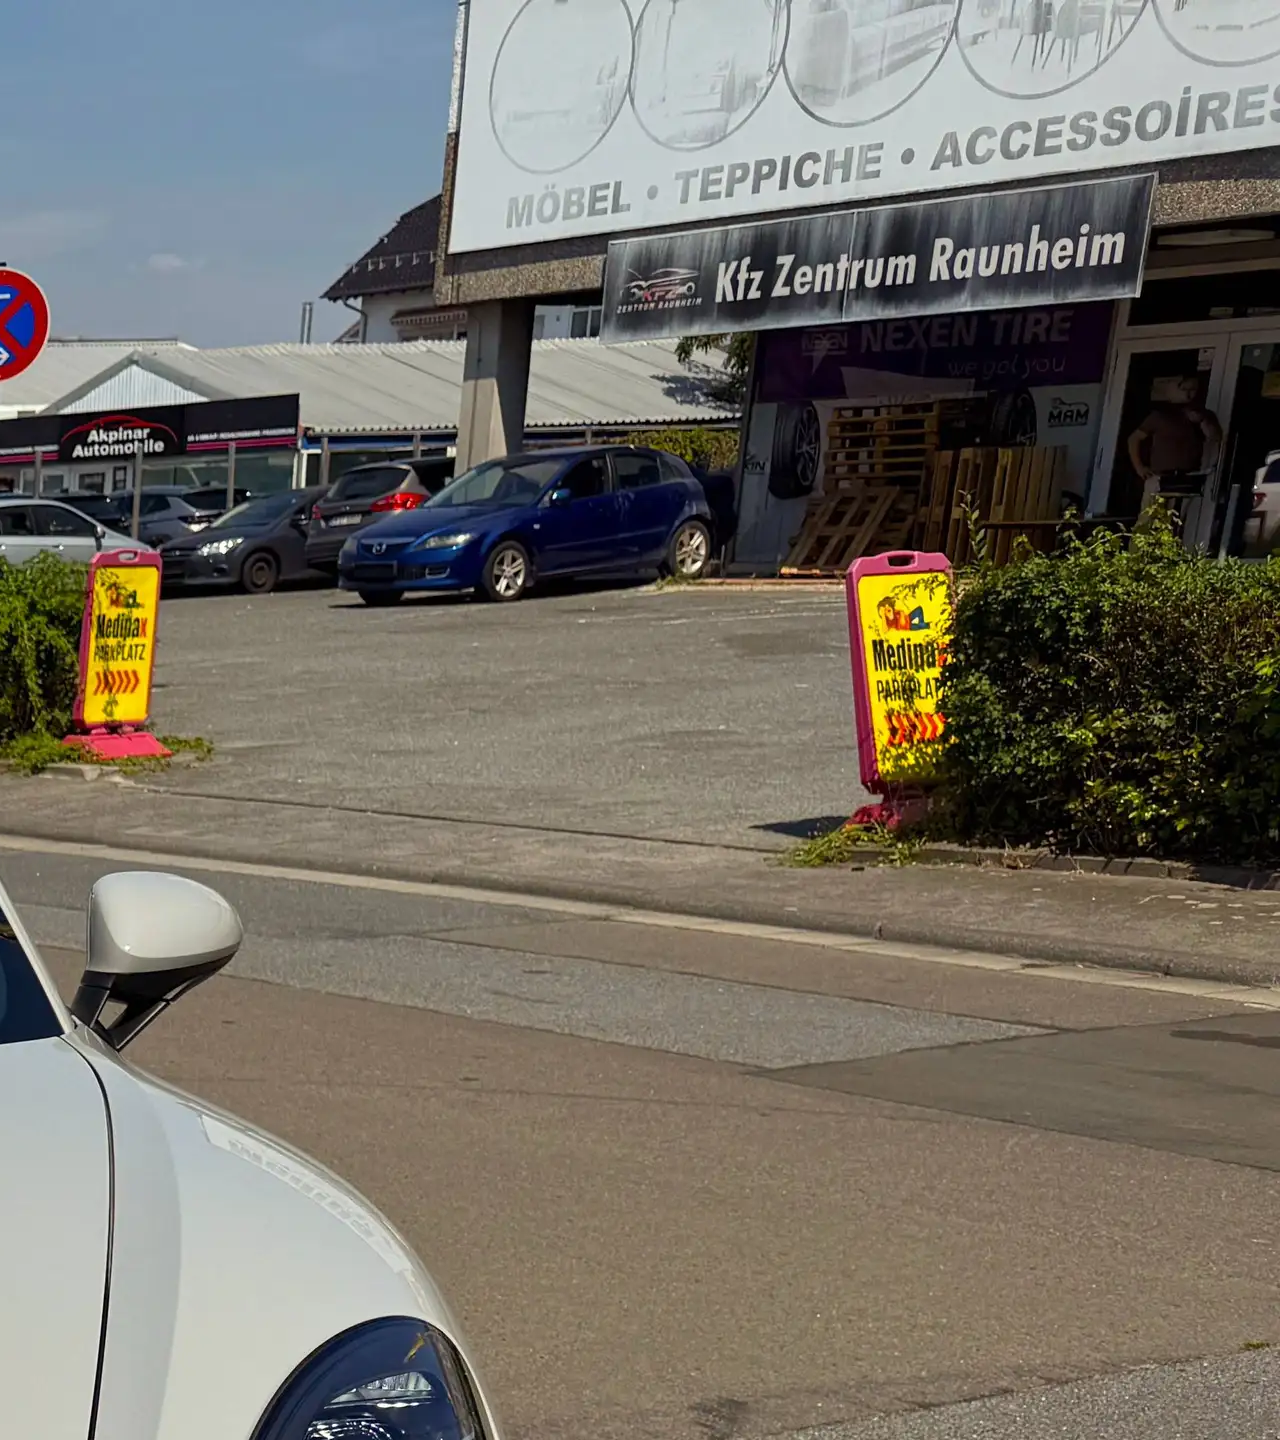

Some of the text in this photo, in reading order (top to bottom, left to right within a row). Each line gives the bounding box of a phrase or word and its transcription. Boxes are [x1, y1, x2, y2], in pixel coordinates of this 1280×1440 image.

[505, 180, 631, 230] MÖBEL
[674, 141, 884, 205] TEPPICHE
[715, 223, 1127, 303] Kfz Zentrum Raunheim
[860, 309, 1075, 354] NEXEN TIRE
[72, 439, 165, 458] Automobile
[87, 426, 150, 444] Akpinar
[96, 612, 148, 640] Medipax
[94, 642, 146, 662] PARKPLATZ
[876, 676, 943, 702] PARKPLAT
